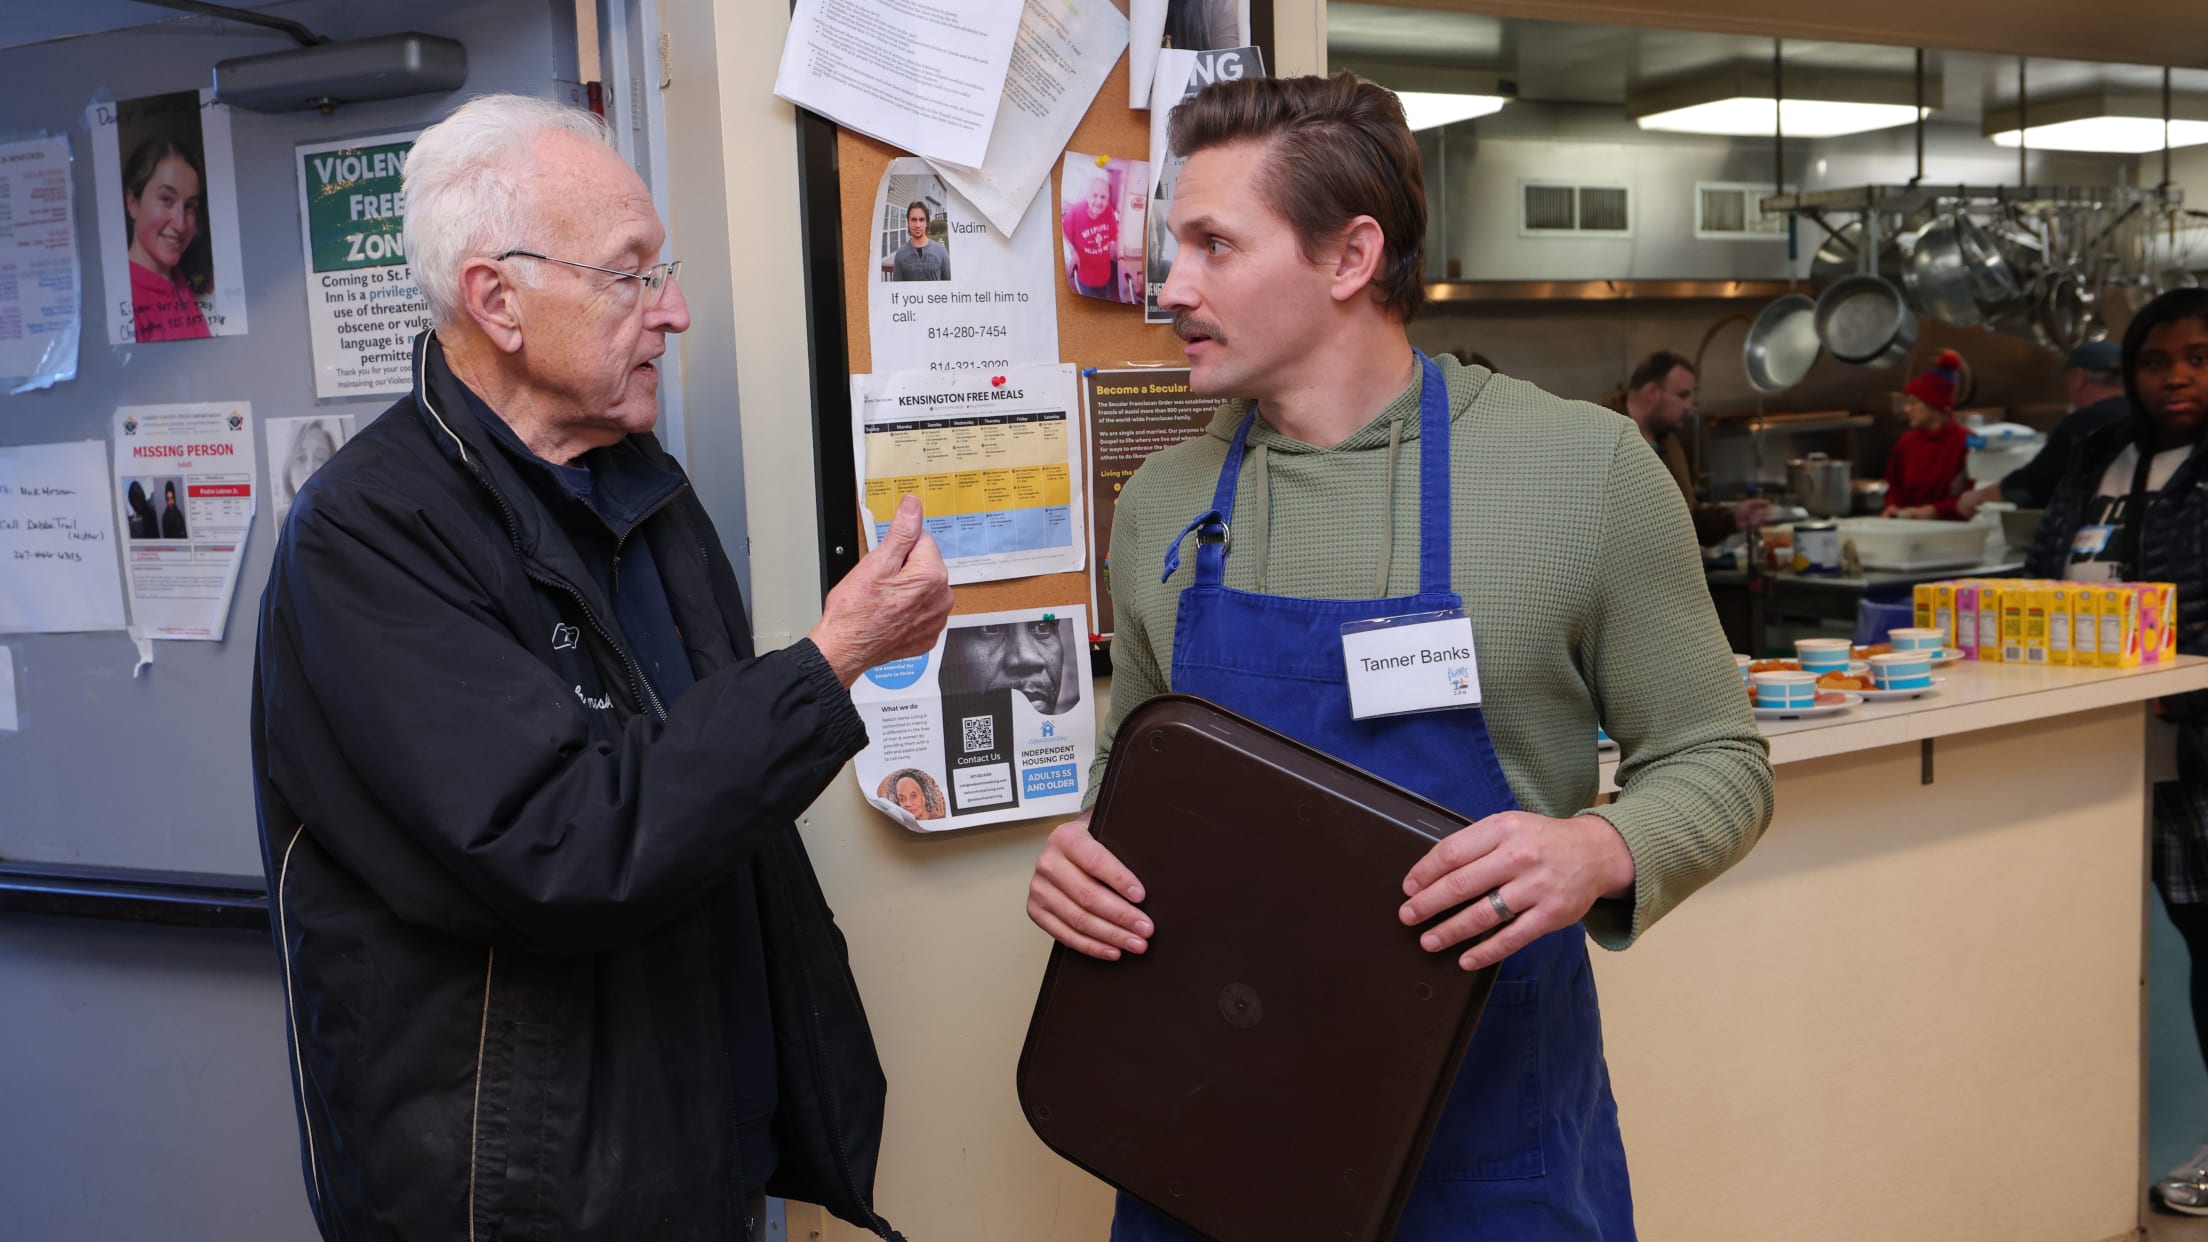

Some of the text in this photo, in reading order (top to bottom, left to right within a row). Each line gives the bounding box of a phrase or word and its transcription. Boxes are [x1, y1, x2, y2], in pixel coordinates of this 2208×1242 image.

[1190, 52, 1244, 86] NG
[314, 150, 407, 184] VIOLEN
[350, 192, 404, 220] FREE
[951, 221, 986, 234] Vadim
[346, 232, 404, 262] ZON
[322, 274, 368, 288] Coming
[372, 274, 384, 283] to
[388, 270, 403, 281] St.
[326, 291, 344, 303] Inn
[348, 290, 356, 301] is
[360, 292, 366, 300] a
[892, 292, 1028, 307] If you see him tell him to
[334, 299, 428, 318] use of threateni
[892, 310, 916, 322] call:
[337, 320, 400, 334] obscene or
[928, 326, 1007, 338] 814-280-7454
[340, 334, 404, 352] language is
[361, 350, 412, 366] permitte
[336, 368, 356, 376] Thank
[358, 368, 370, 376] you
[371, 366, 381, 374] for
[384, 366, 398, 374] your
[337, 378, 386, 388] maintaining our
[1096, 384, 1188, 395] Become a Secular
[899, 390, 1024, 406] KENSINGTON FREE MEALS
[133, 444, 234, 458] MISSING PERSON
[1101, 470, 1120, 478] Living
[1360, 646, 1470, 672] Tanner Banks
[1022, 745, 1074, 758] INDEPENDENT
[958, 752, 1001, 765] Contact Us
[1022, 754, 1074, 766] HOUSING FOR
[1028, 770, 1060, 782] ADULTS
[1027, 780, 1074, 792] AND OLDER
